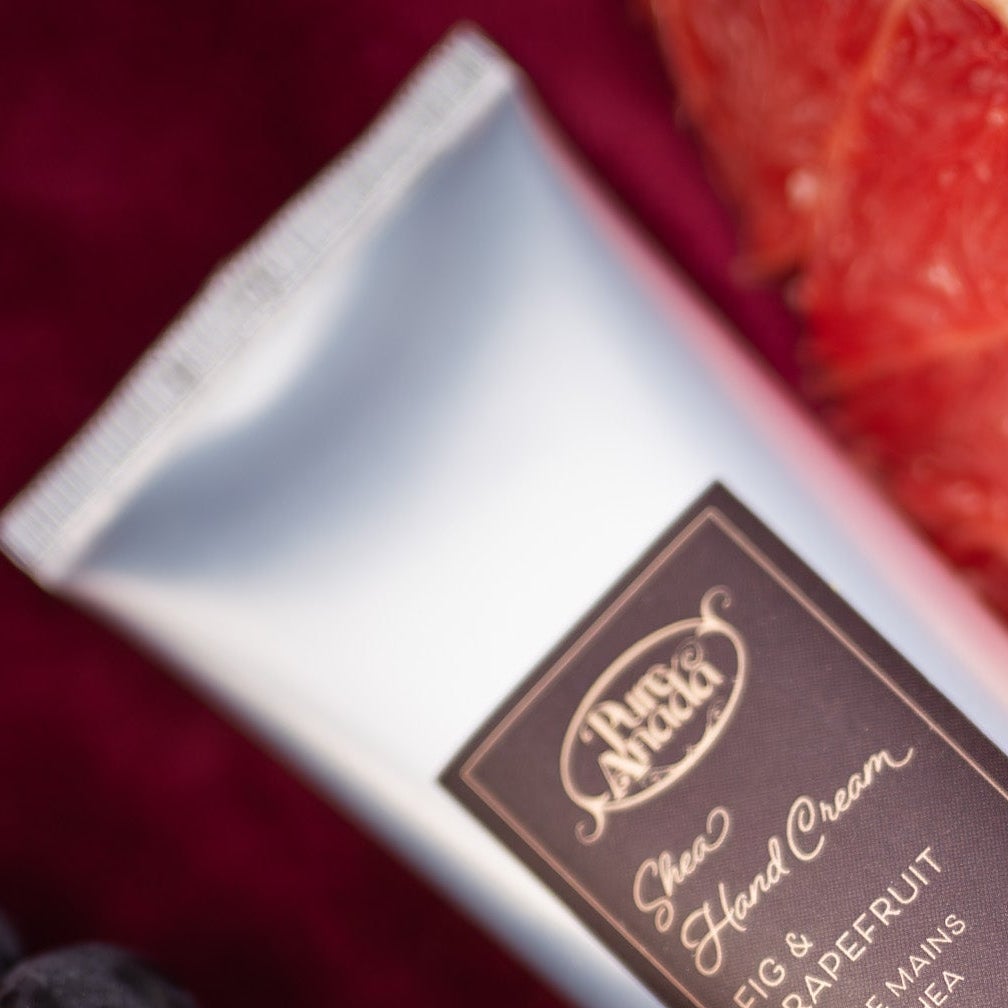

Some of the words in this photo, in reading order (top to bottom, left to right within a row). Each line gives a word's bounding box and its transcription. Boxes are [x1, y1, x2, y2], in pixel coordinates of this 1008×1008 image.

[579, 663, 674, 756] Pure
[598, 640, 724, 799] Anada
[633, 806, 730, 933] Shea
[680, 836, 790, 976] Hand
[786, 747, 914, 861] Cream
[785, 932, 813, 958] &
[885, 914, 966, 998] MAINS
